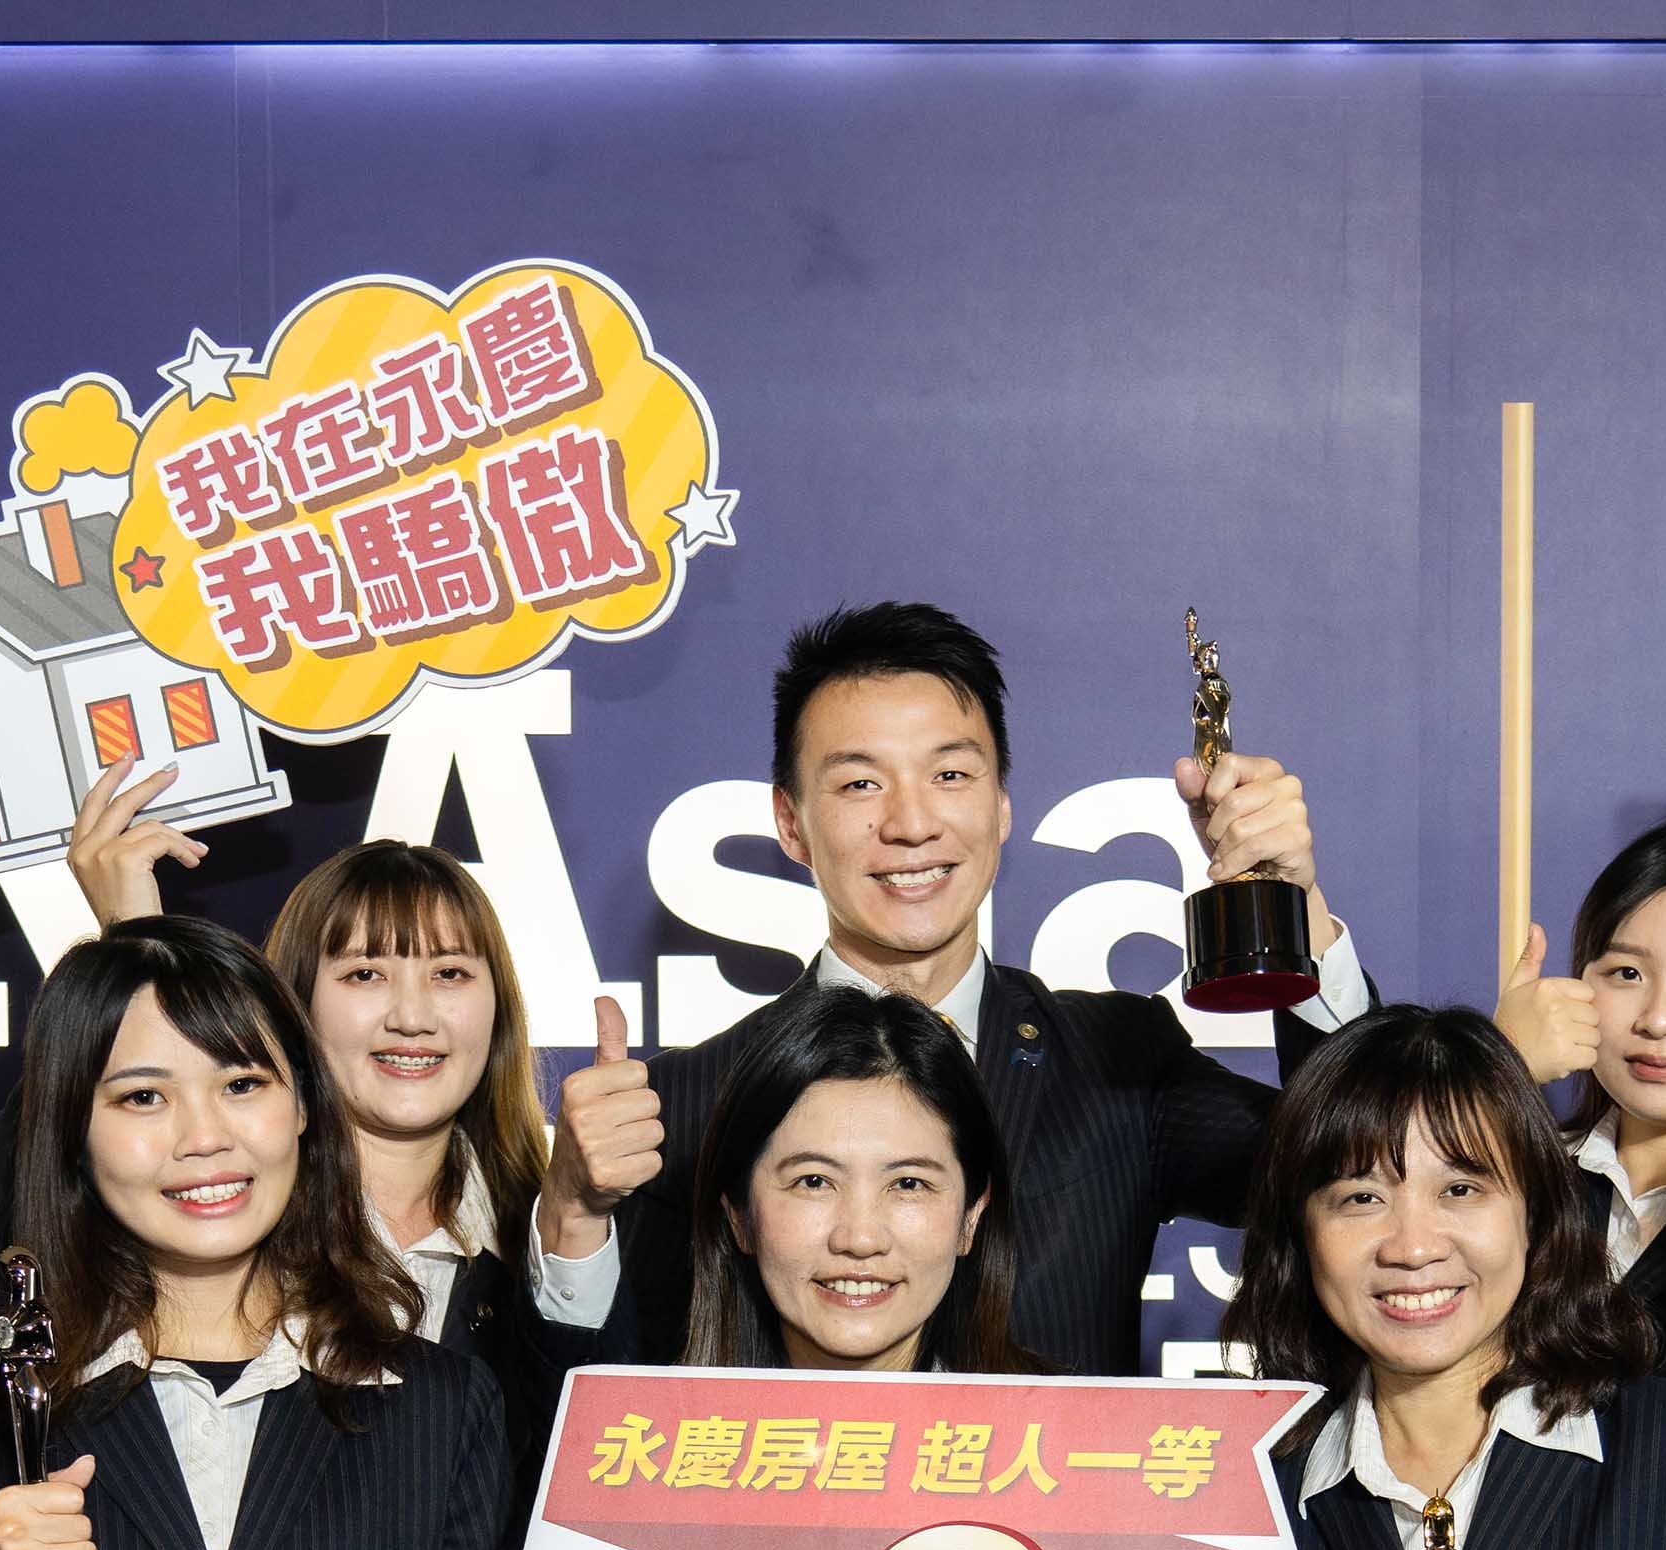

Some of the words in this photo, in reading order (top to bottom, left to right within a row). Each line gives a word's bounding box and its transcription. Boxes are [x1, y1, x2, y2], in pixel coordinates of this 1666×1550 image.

[162, 276, 588, 537] 我在永慶
[199, 430, 639, 660] 我驕傲
[589, 1413, 896, 1492] 永慶房屋
[910, 1421, 1221, 1499] 超人一等
